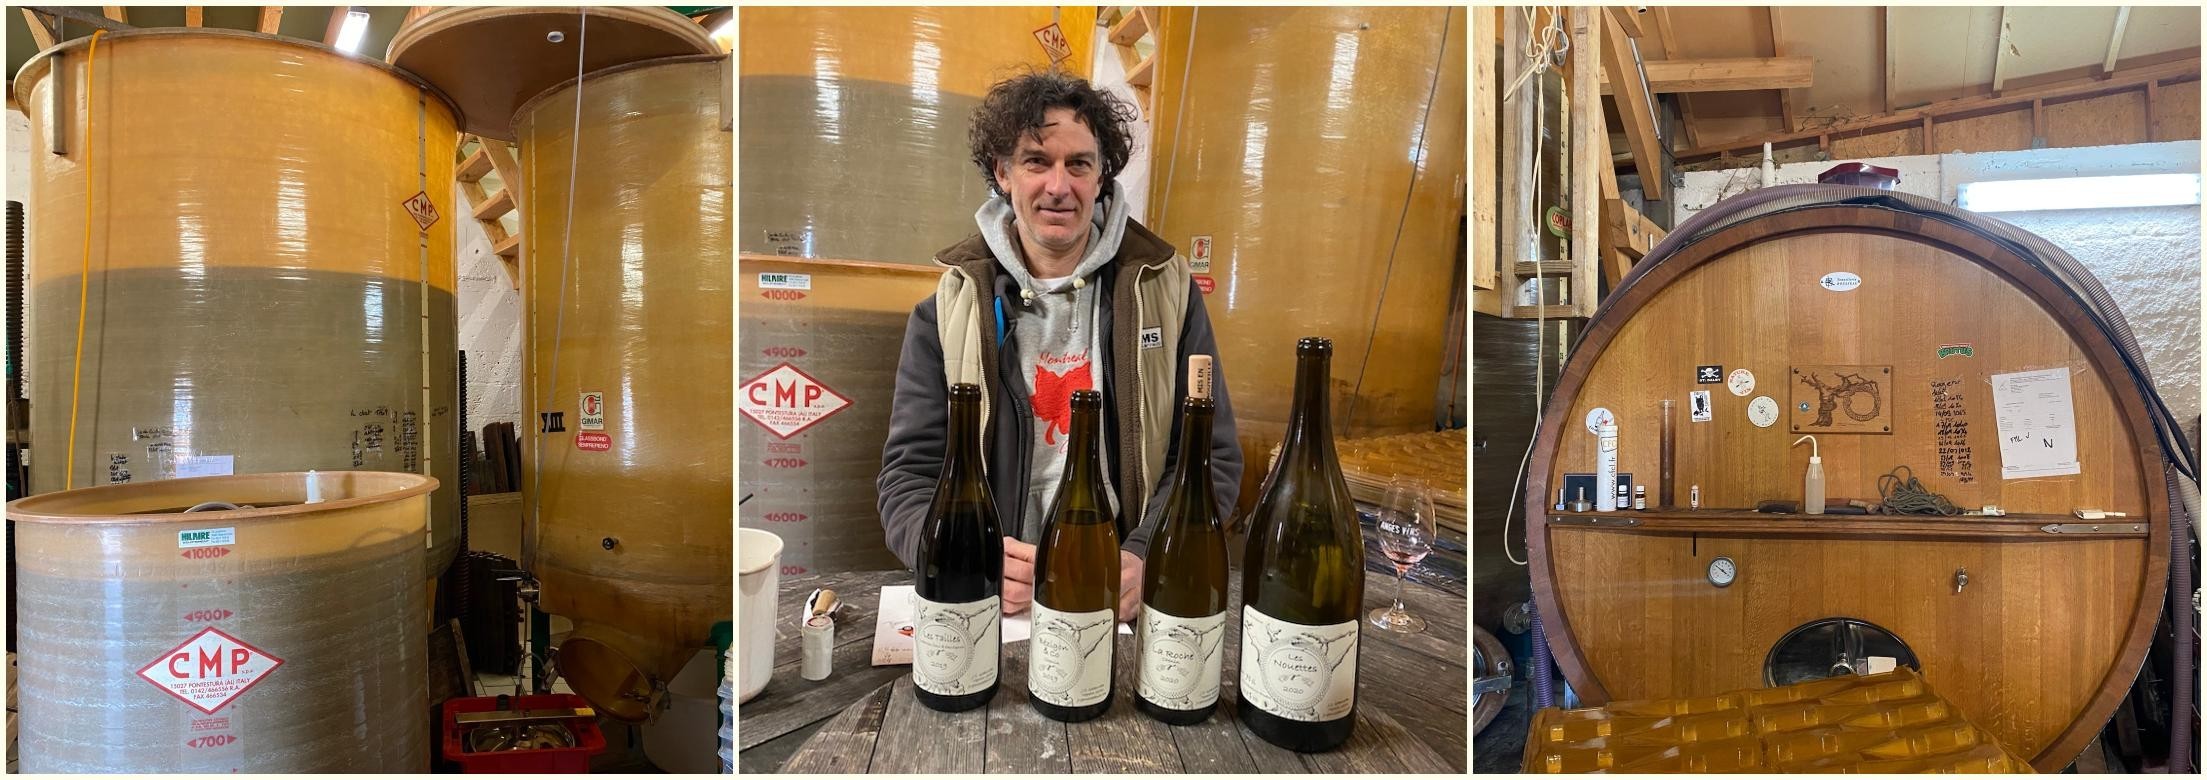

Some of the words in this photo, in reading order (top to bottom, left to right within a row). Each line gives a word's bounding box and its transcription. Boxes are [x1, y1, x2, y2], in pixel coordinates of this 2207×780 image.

[1043, 30, 1065, 50] CMP
[412, 199, 433, 216] CMP
[770, 290, 797, 300] 1000
[771, 347, 797, 357] 900
[748, 377, 822, 408] CMP
[773, 458, 798, 468] 700
[772, 512, 798, 522] 600
[192, 547, 220, 559] 1000
[781, 566, 798, 575] 00
[193, 609, 223, 621] 900
[168, 643, 250, 679] CMP
[1288, 653, 1303, 662] Les
[1273, 660, 1318, 673] Nouettes
[188, 679, 223, 689] PONTESTURA
[1283, 686, 1304, 695] 2020
[198, 735, 226, 748] 700
